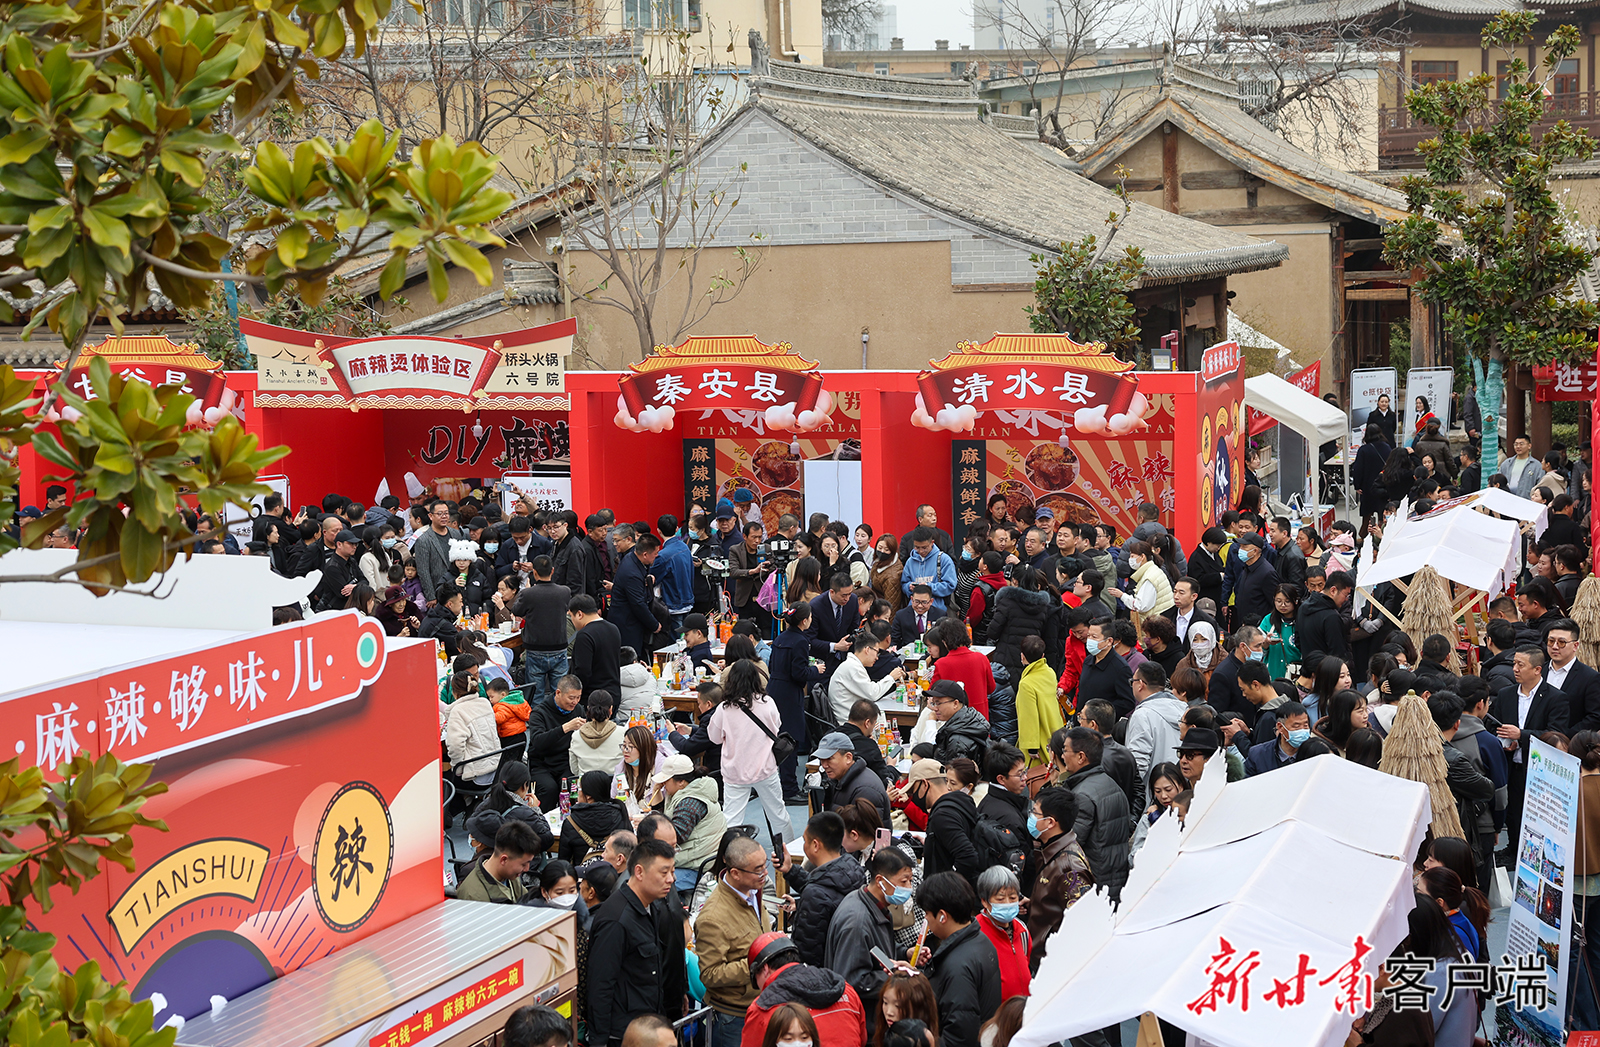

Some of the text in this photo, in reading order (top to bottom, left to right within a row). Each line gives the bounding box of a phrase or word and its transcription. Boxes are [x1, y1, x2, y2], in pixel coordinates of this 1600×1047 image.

[265, 368, 319, 379] 天水古城
[348, 352, 472, 380] 麻辣烫体验区
[505, 352, 559, 367] 桥头火锅
[505, 372, 560, 387] 六号院
[655, 368, 785, 405] 秦安县
[952, 370, 1097, 405] 清水县
[421, 425, 493, 465] DIY
[697, 426, 739, 436] TIAN
[690, 446, 712, 515] 麻辣鲜
[959, 447, 981, 526] 麻辣鲜香
[1107, 451, 1175, 490] 麻辣
[329, 817, 374, 903] 辣
[124, 857, 256, 929] TIANSHUI
[442, 966, 519, 1023] 麻辣粉六元一碗
